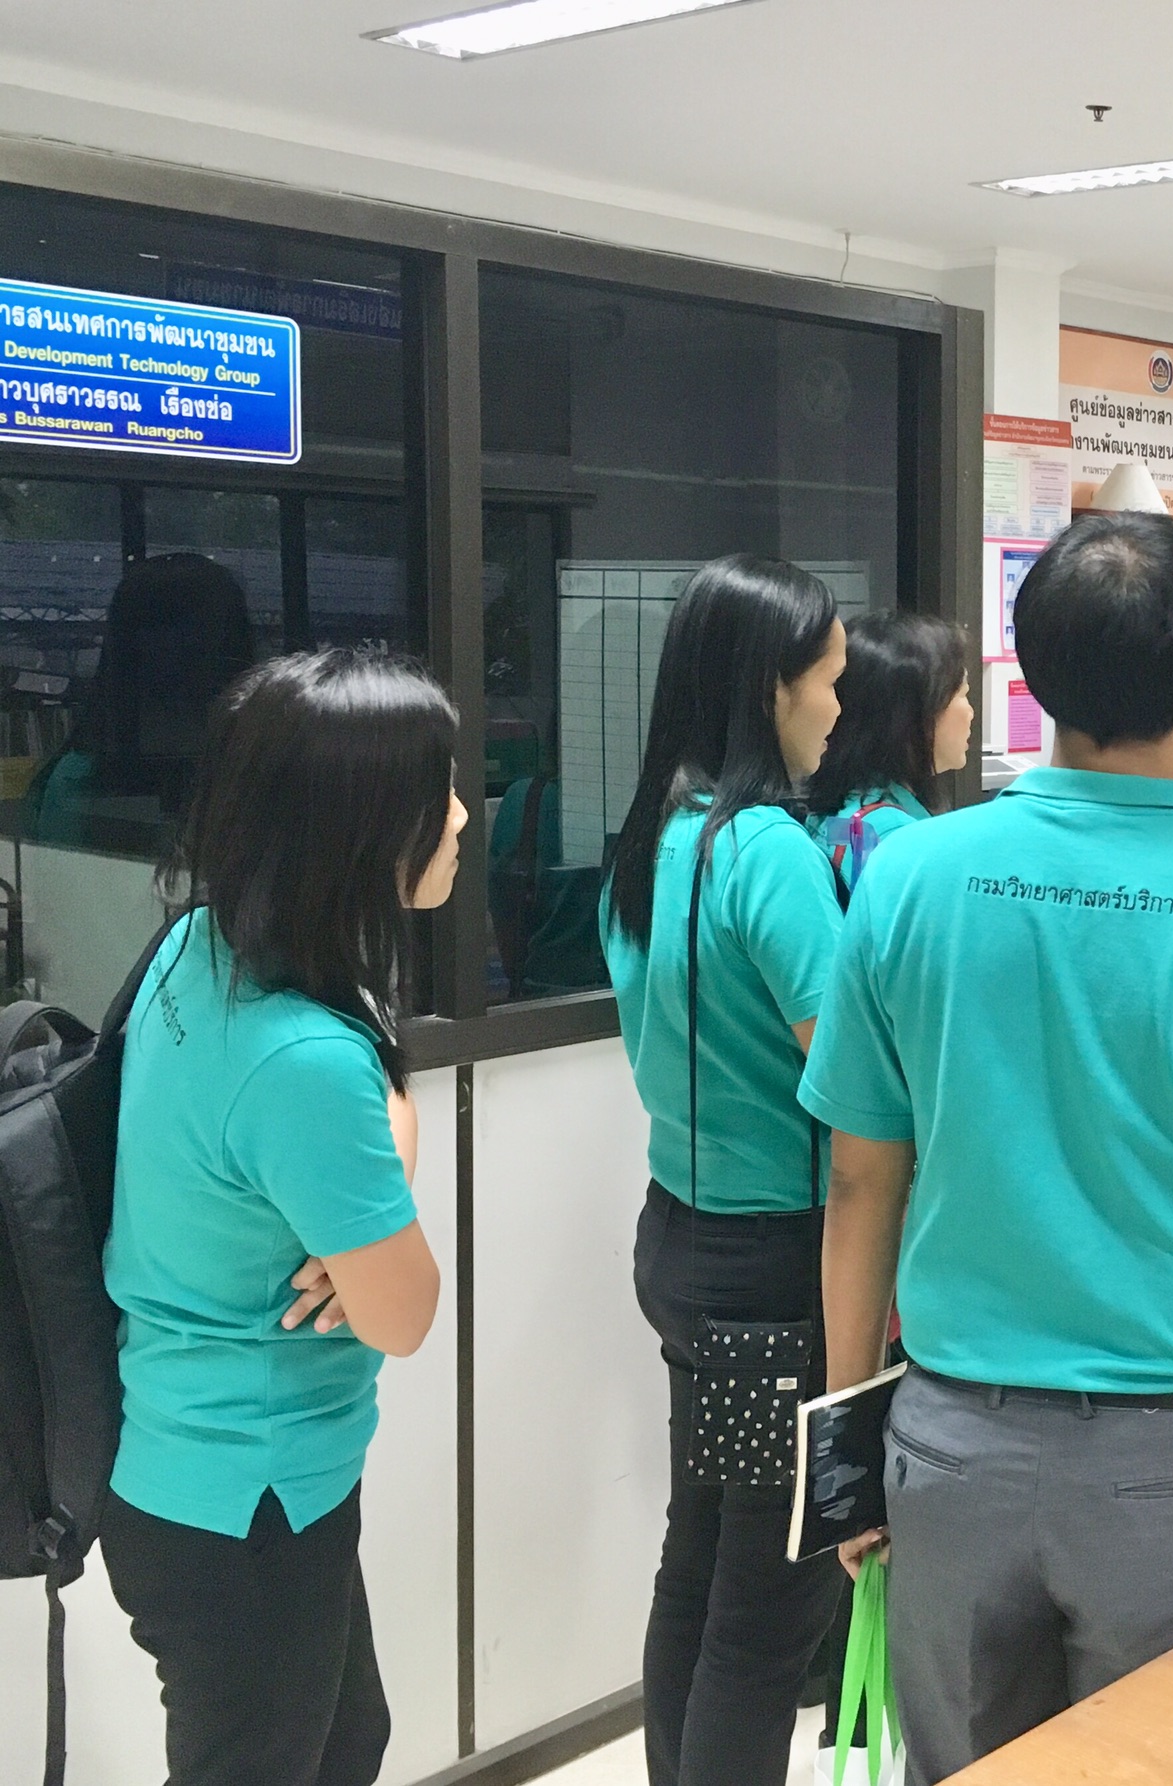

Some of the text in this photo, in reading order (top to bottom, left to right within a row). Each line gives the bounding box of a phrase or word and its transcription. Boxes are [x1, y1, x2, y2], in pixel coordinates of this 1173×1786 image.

[4, 340, 261, 388] Development Technology Group
[14, 410, 114, 433] Bussarawan
[127, 421, 204, 441] Ruangcho
